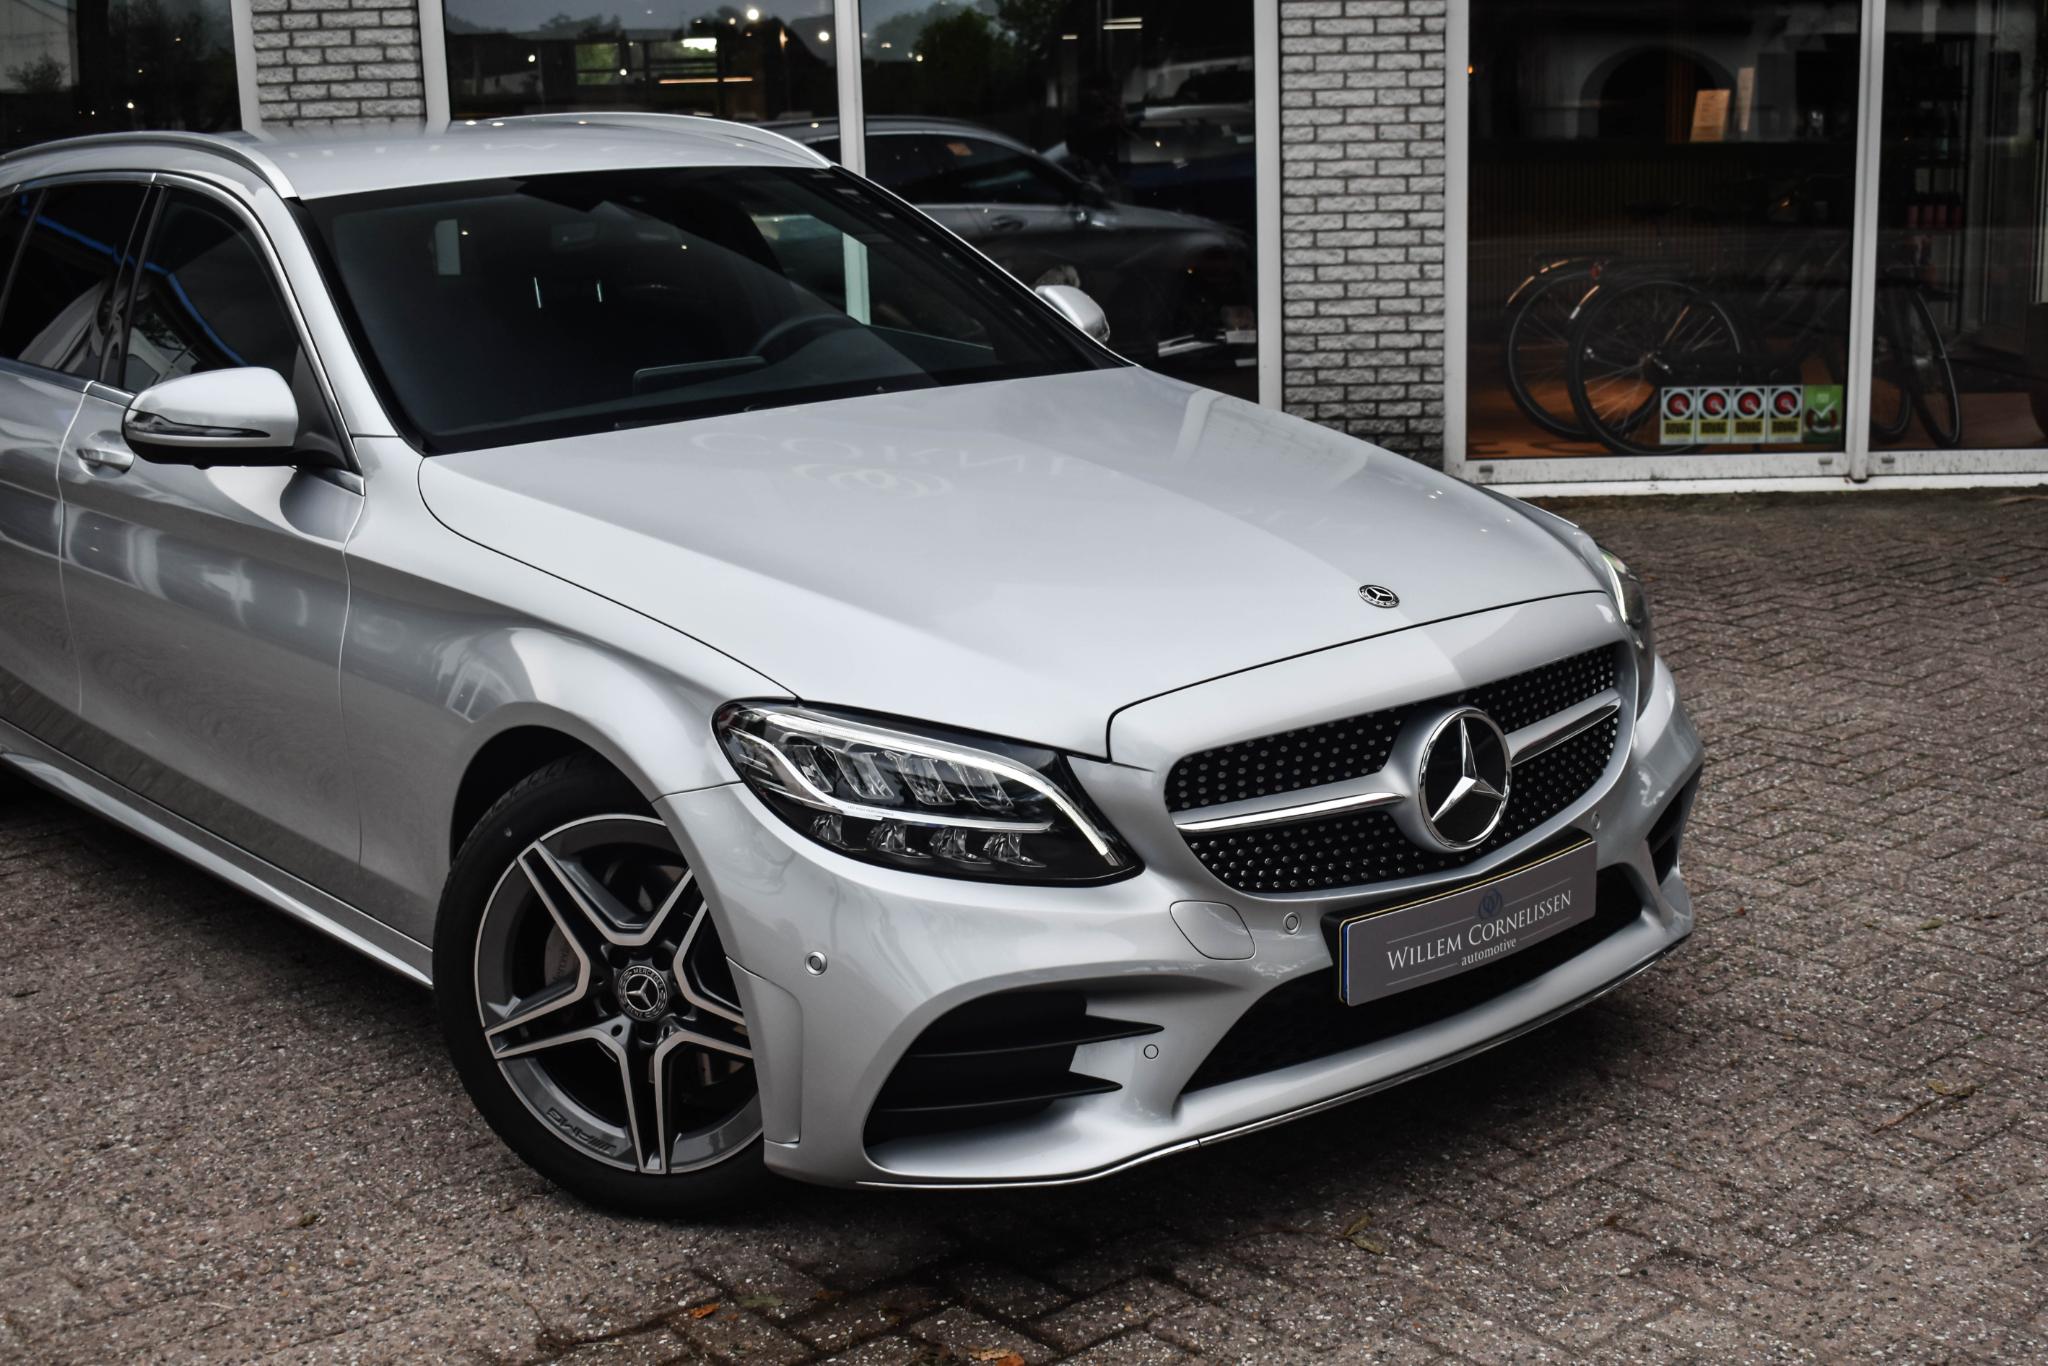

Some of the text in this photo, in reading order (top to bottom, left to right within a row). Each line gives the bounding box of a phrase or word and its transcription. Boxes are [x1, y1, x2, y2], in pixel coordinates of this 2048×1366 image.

[1387, 890, 1572, 971] WILLEM CORNELISSEN
[1461, 937, 1517, 966] automotive
